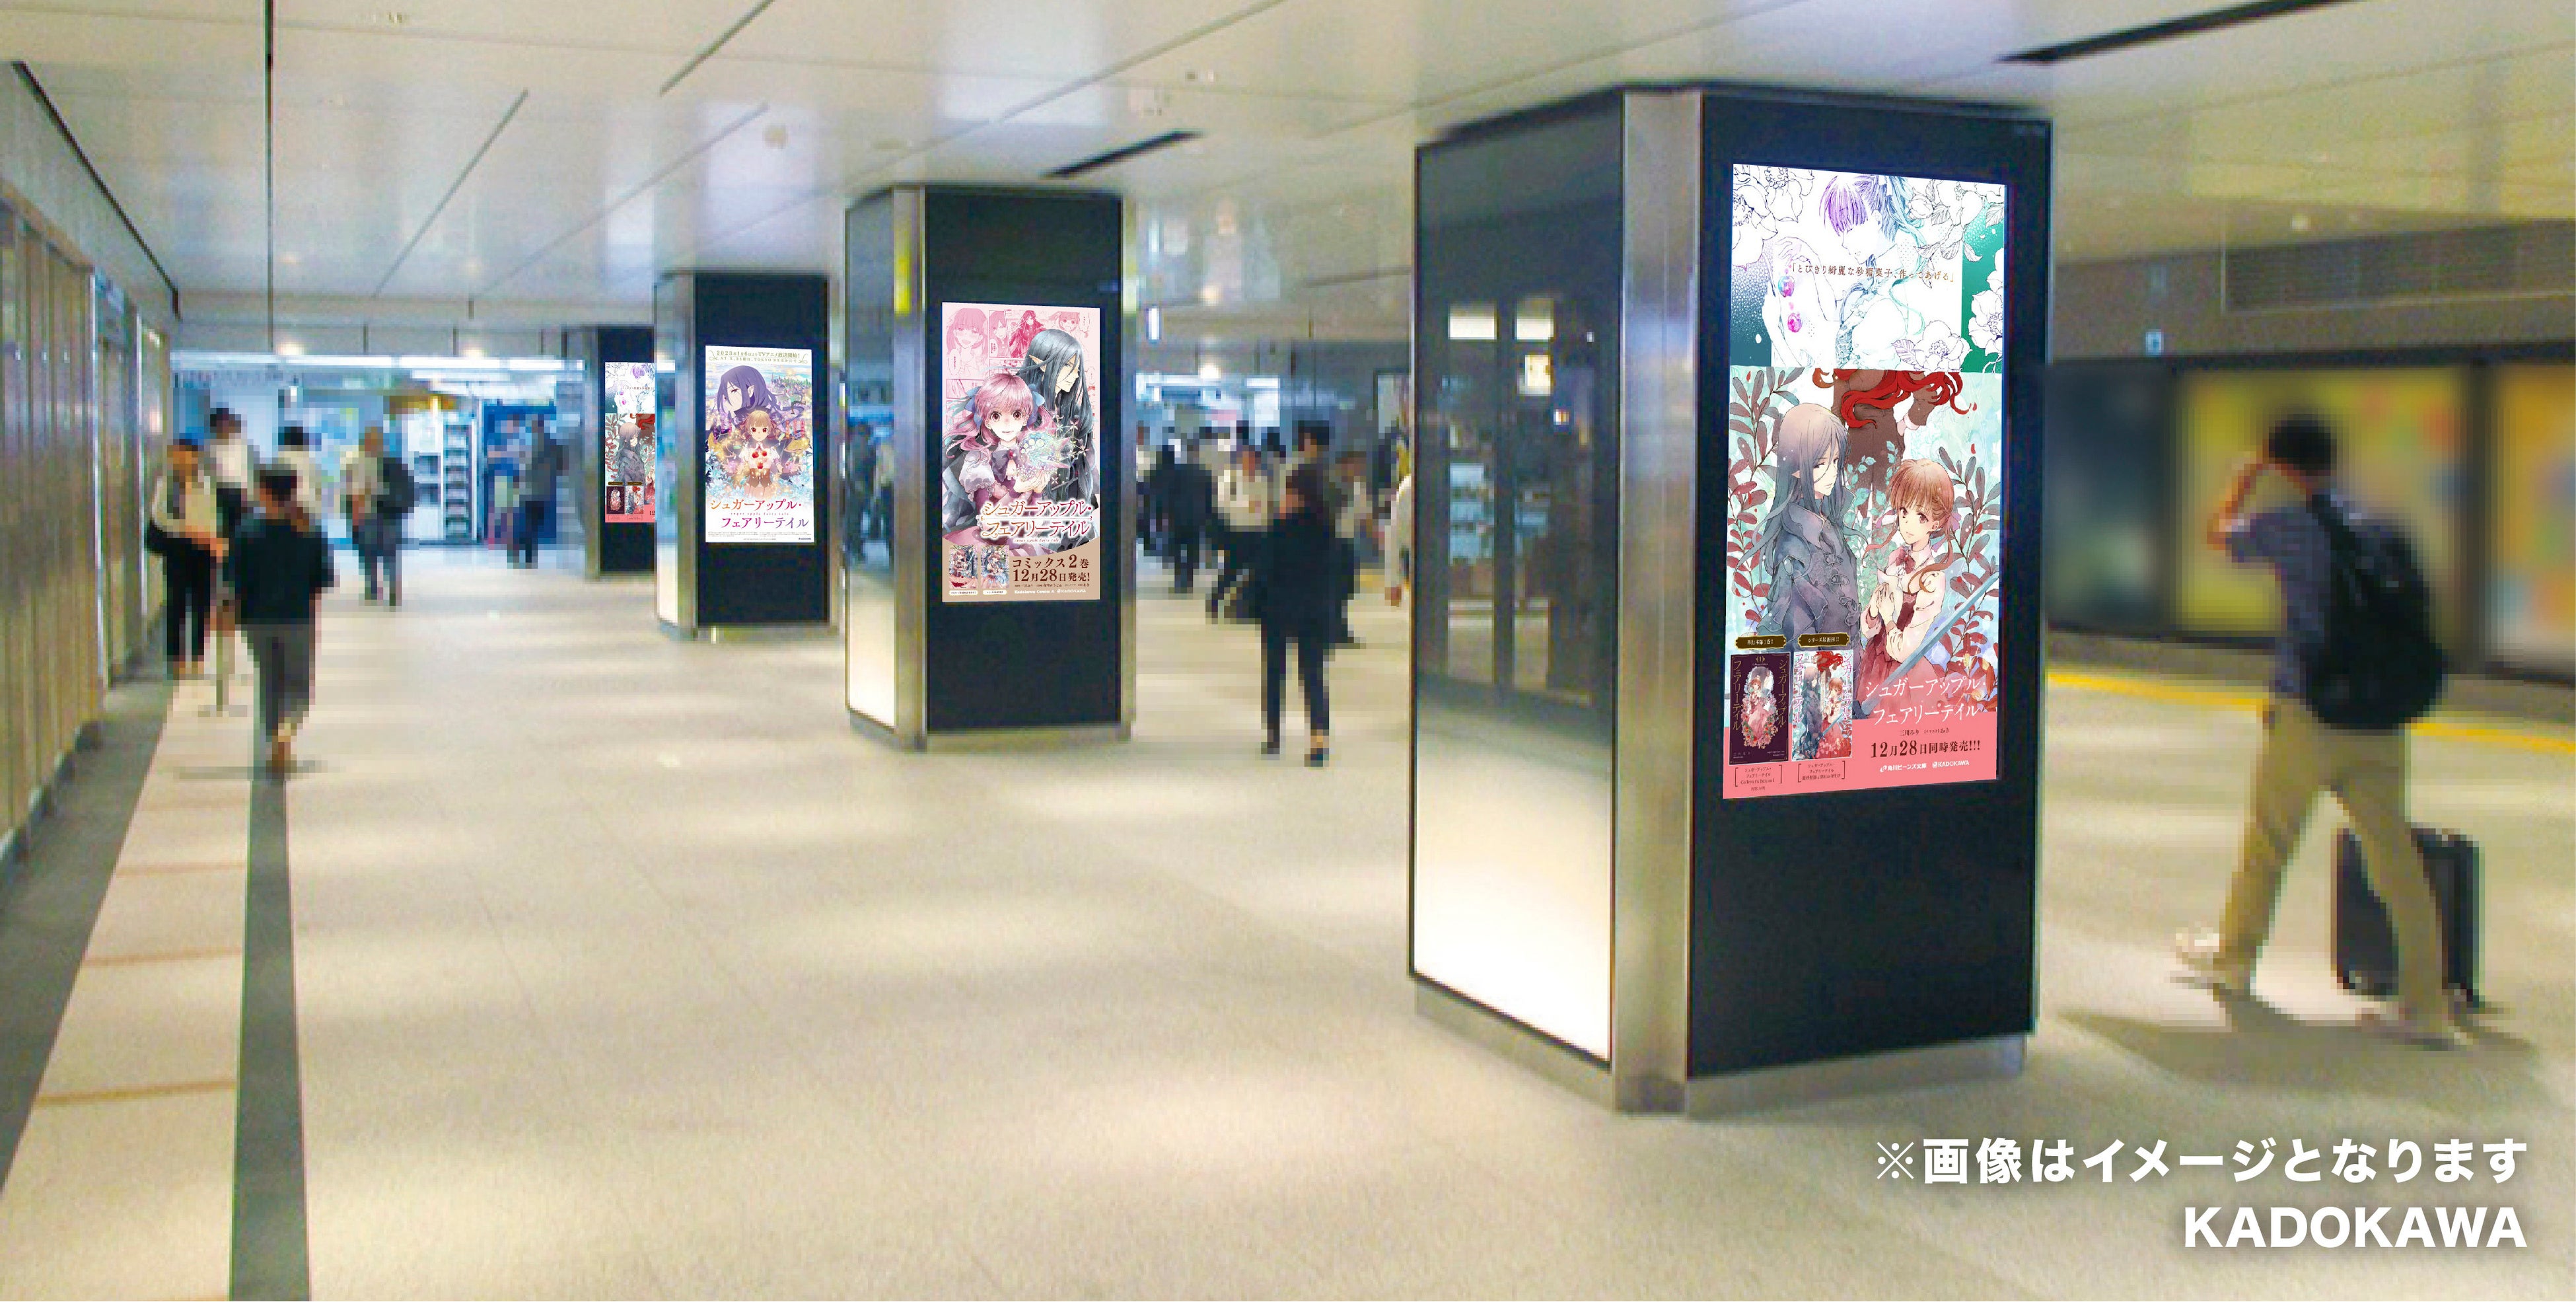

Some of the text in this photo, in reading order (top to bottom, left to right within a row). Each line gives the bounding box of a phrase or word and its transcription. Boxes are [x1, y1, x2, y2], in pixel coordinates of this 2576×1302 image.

[721, 517, 809, 528] フェアリーテイル
[982, 521, 1091, 538] フェアリーテイル
[1013, 569, 1090, 582] 12月28日発売!
[1873, 703, 1980, 725] フェアリーテイル
[1871, 740, 1980, 758] 12月28日同時発売!!!
